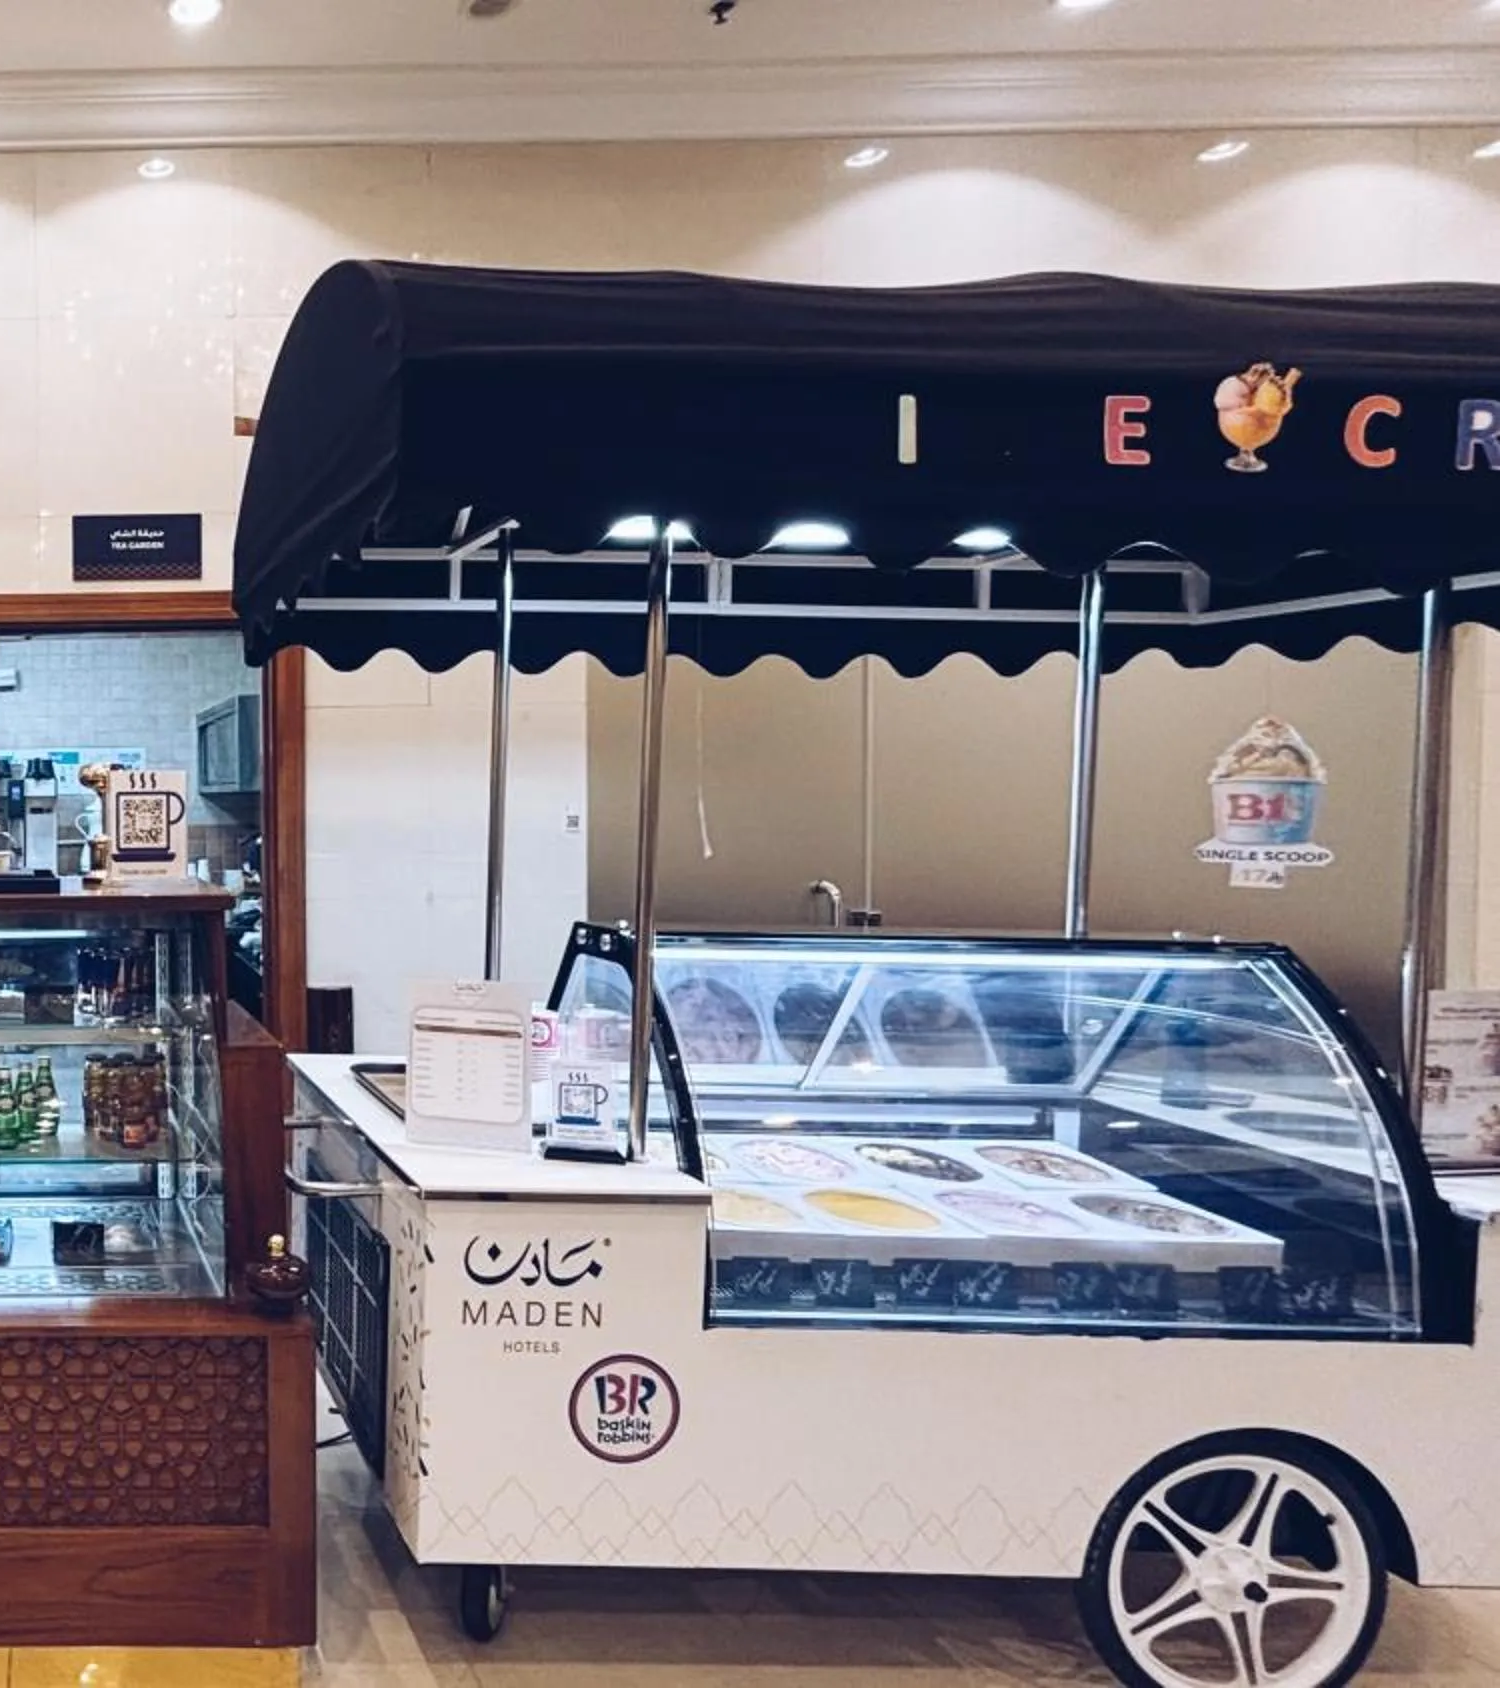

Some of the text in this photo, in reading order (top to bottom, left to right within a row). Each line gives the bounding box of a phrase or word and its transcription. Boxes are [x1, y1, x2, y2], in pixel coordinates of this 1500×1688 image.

[897, 393, 917, 465] I
[111, 541, 164, 550] TEA GARDEN
[1197, 850, 1329, 863] SINGLE SCOOP
[461, 1300, 602, 1328] MADEN
[503, 1341, 560, 1354] HOTELS
[594, 1373, 657, 1415] BR
[597, 1416, 651, 1435] baskin
[597, 1431, 651, 1446] robbins
